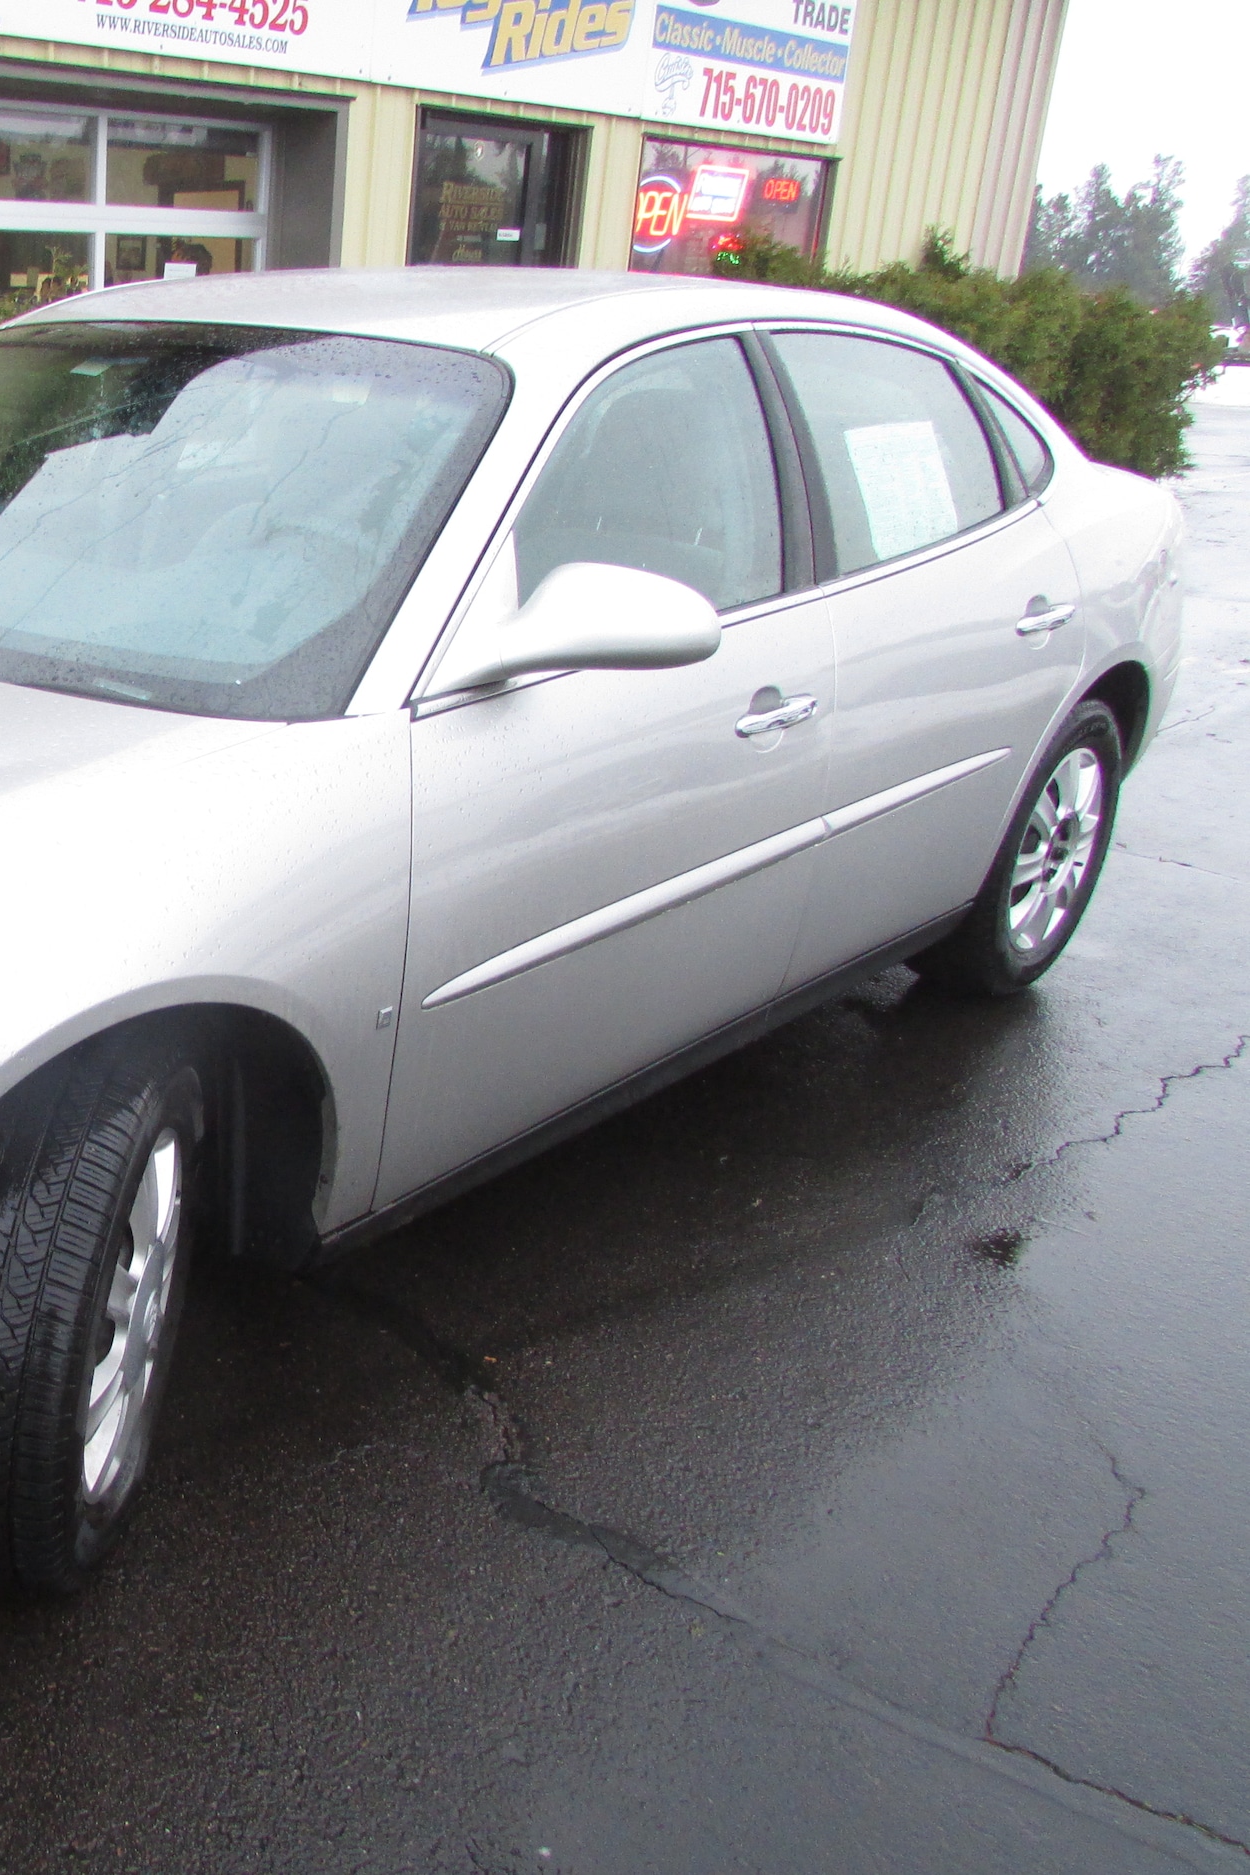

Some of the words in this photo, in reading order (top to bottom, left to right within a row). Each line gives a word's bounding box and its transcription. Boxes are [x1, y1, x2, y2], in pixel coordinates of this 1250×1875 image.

[77, 0, 308, 35] 4-4525
[96, 14, 288, 54] WWW.RIVERSIDEAUTOSALES.COM
[488, 0, 634, 67] Rides
[792, 0, 851, 35] TRADE
[655, 11, 714, 51] Classic
[721, 26, 776, 64] Muscle
[783, 39, 847, 77] Collector
[699, 67, 836, 136] 715-670-0209
[763, 178, 800, 201] OPEN
[636, 191, 688, 236] PEN
